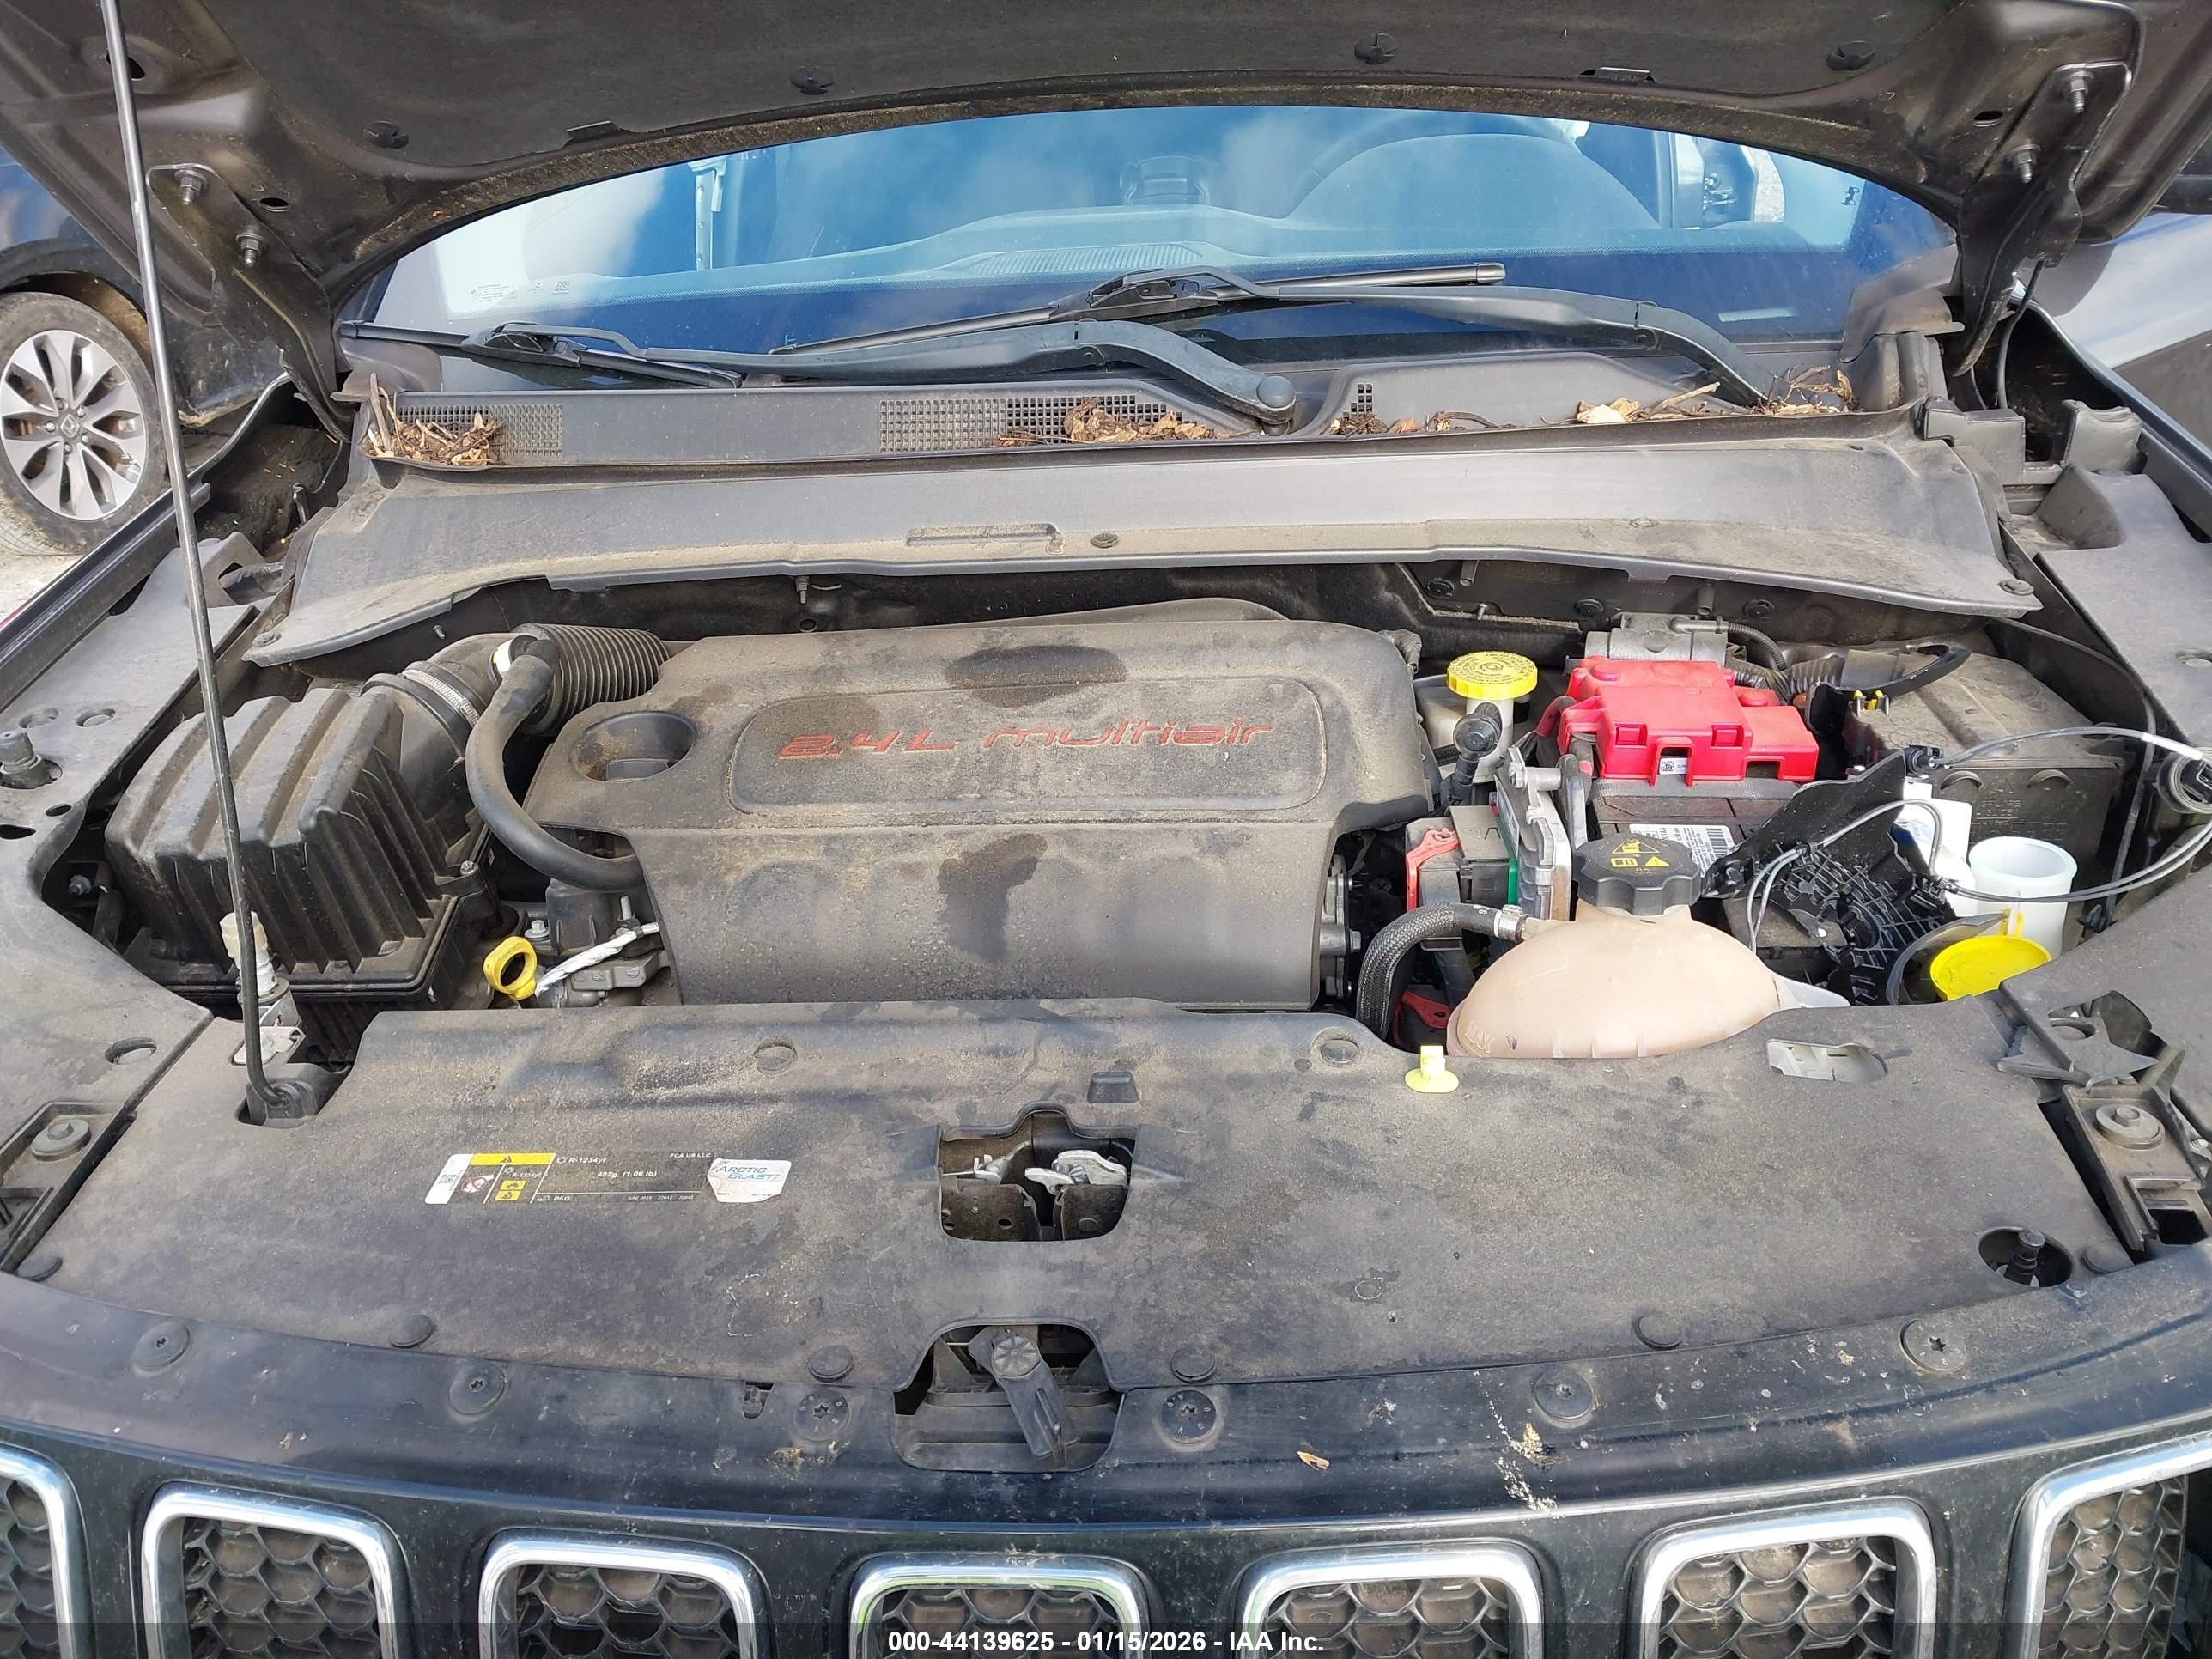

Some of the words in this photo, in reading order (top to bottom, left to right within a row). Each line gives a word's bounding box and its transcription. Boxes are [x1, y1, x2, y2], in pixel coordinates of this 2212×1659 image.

[779, 729, 956, 759] 2.4L
[982, 715, 1275, 749] multiair
[568, 1156, 607, 1164] R-1234yf
[716, 1165, 767, 1174] ARCTIC
